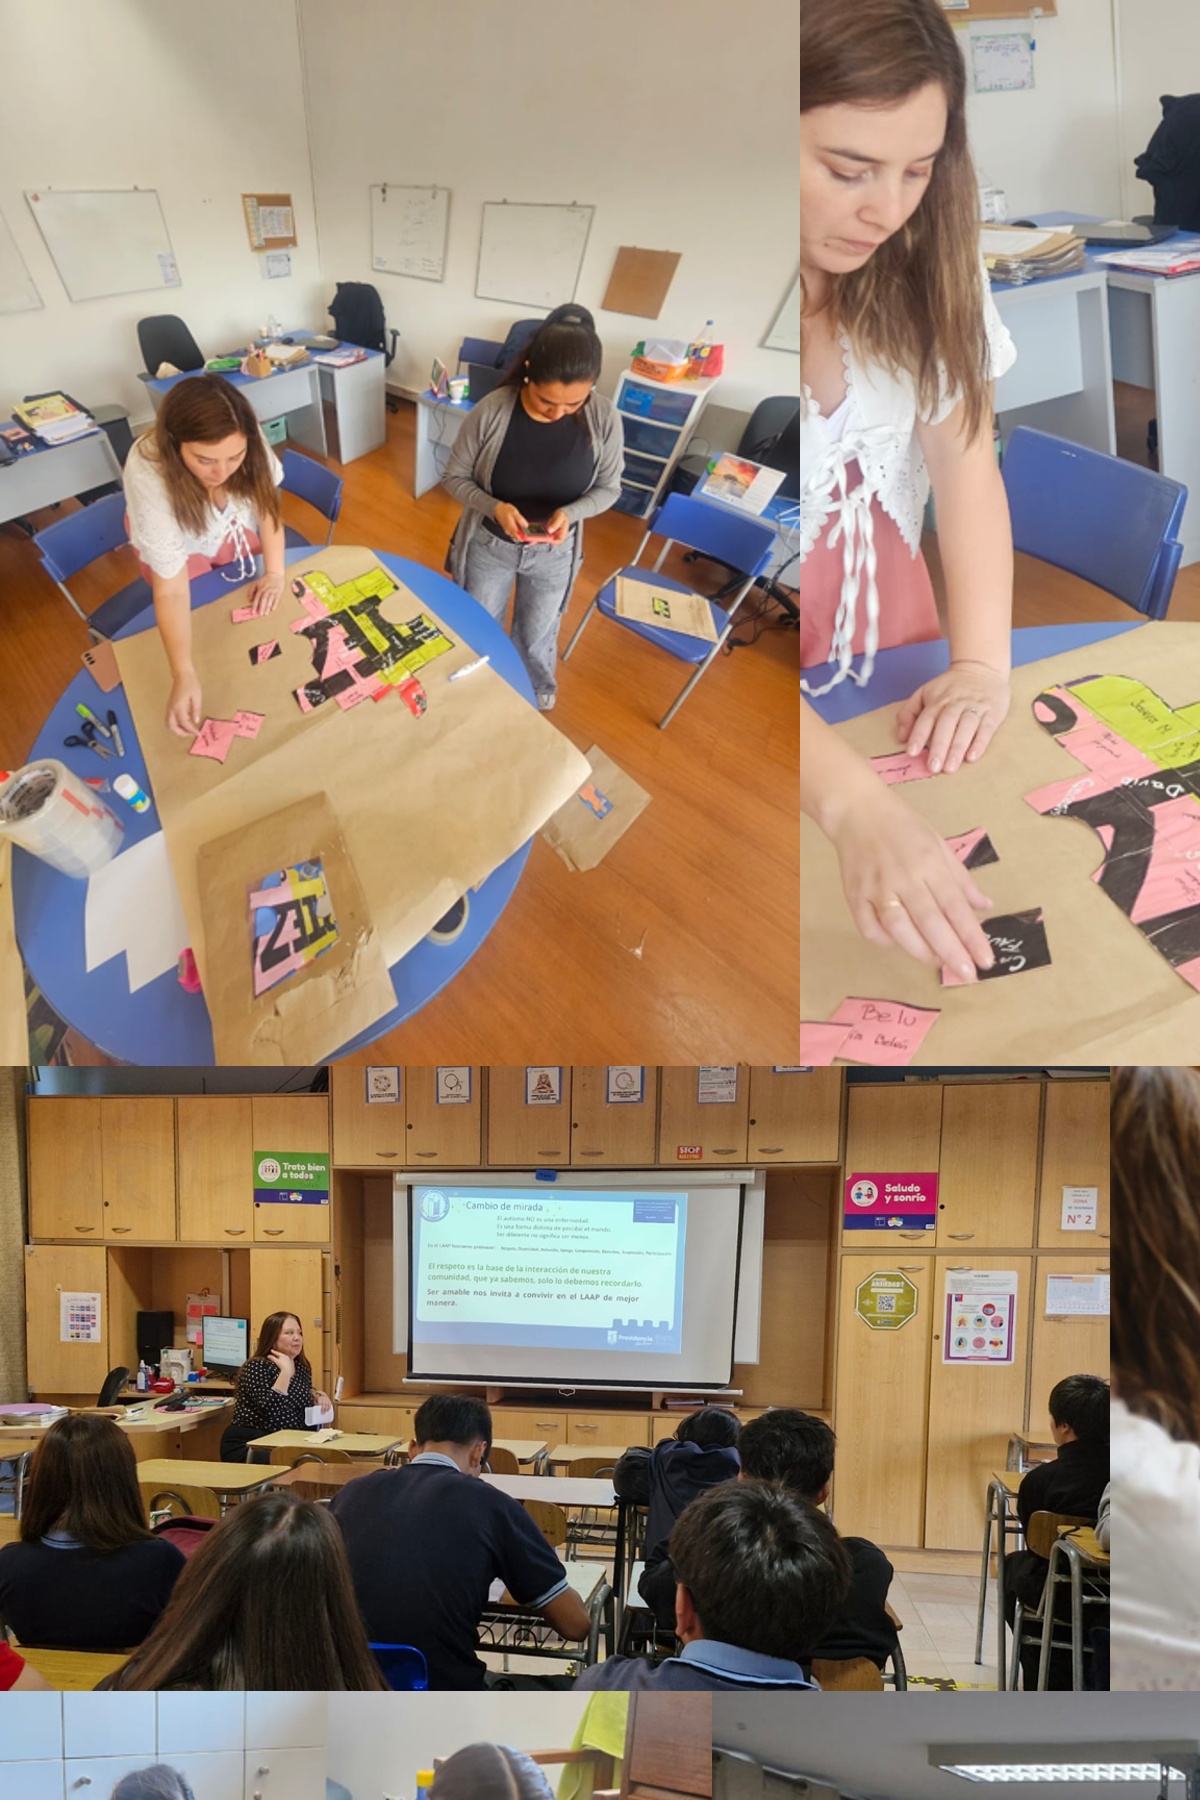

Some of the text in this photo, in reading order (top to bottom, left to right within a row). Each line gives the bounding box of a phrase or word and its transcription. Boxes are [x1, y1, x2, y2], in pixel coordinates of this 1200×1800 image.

[282, 1162, 326, 1171] Trato bien
[290, 1171, 314, 1179] todos
[885, 1183, 921, 1193] Saludo
[885, 1193, 926, 1204] y sonrío
[466, 1201, 543, 1212] Cambio de mirada
[1085, 1215, 1092, 1224] 2
[436, 1263, 465, 1273] respeto
[477, 1263, 484, 1271] la
[486, 1264, 504, 1272] base
[505, 1264, 515, 1272] de
[516, 1265, 524, 1273] la
[581, 1267, 611, 1276] nuestra
[473, 1275, 487, 1284] que
[489, 1276, 498, 1285] ya
[538, 1275, 553, 1284] solo
[555, 1277, 563, 1285] lo
[564, 1277, 599, 1287] debemos
[427, 1288, 439, 1296] Ser
[442, 1288, 470, 1297] amable
[490, 1290, 512, 1298] invita
[523, 1291, 553, 1299] convivir
[570, 1292, 577, 1300] el
[580, 1293, 601, 1301] LAAP
[616, 1295, 639, 1304] mejor
